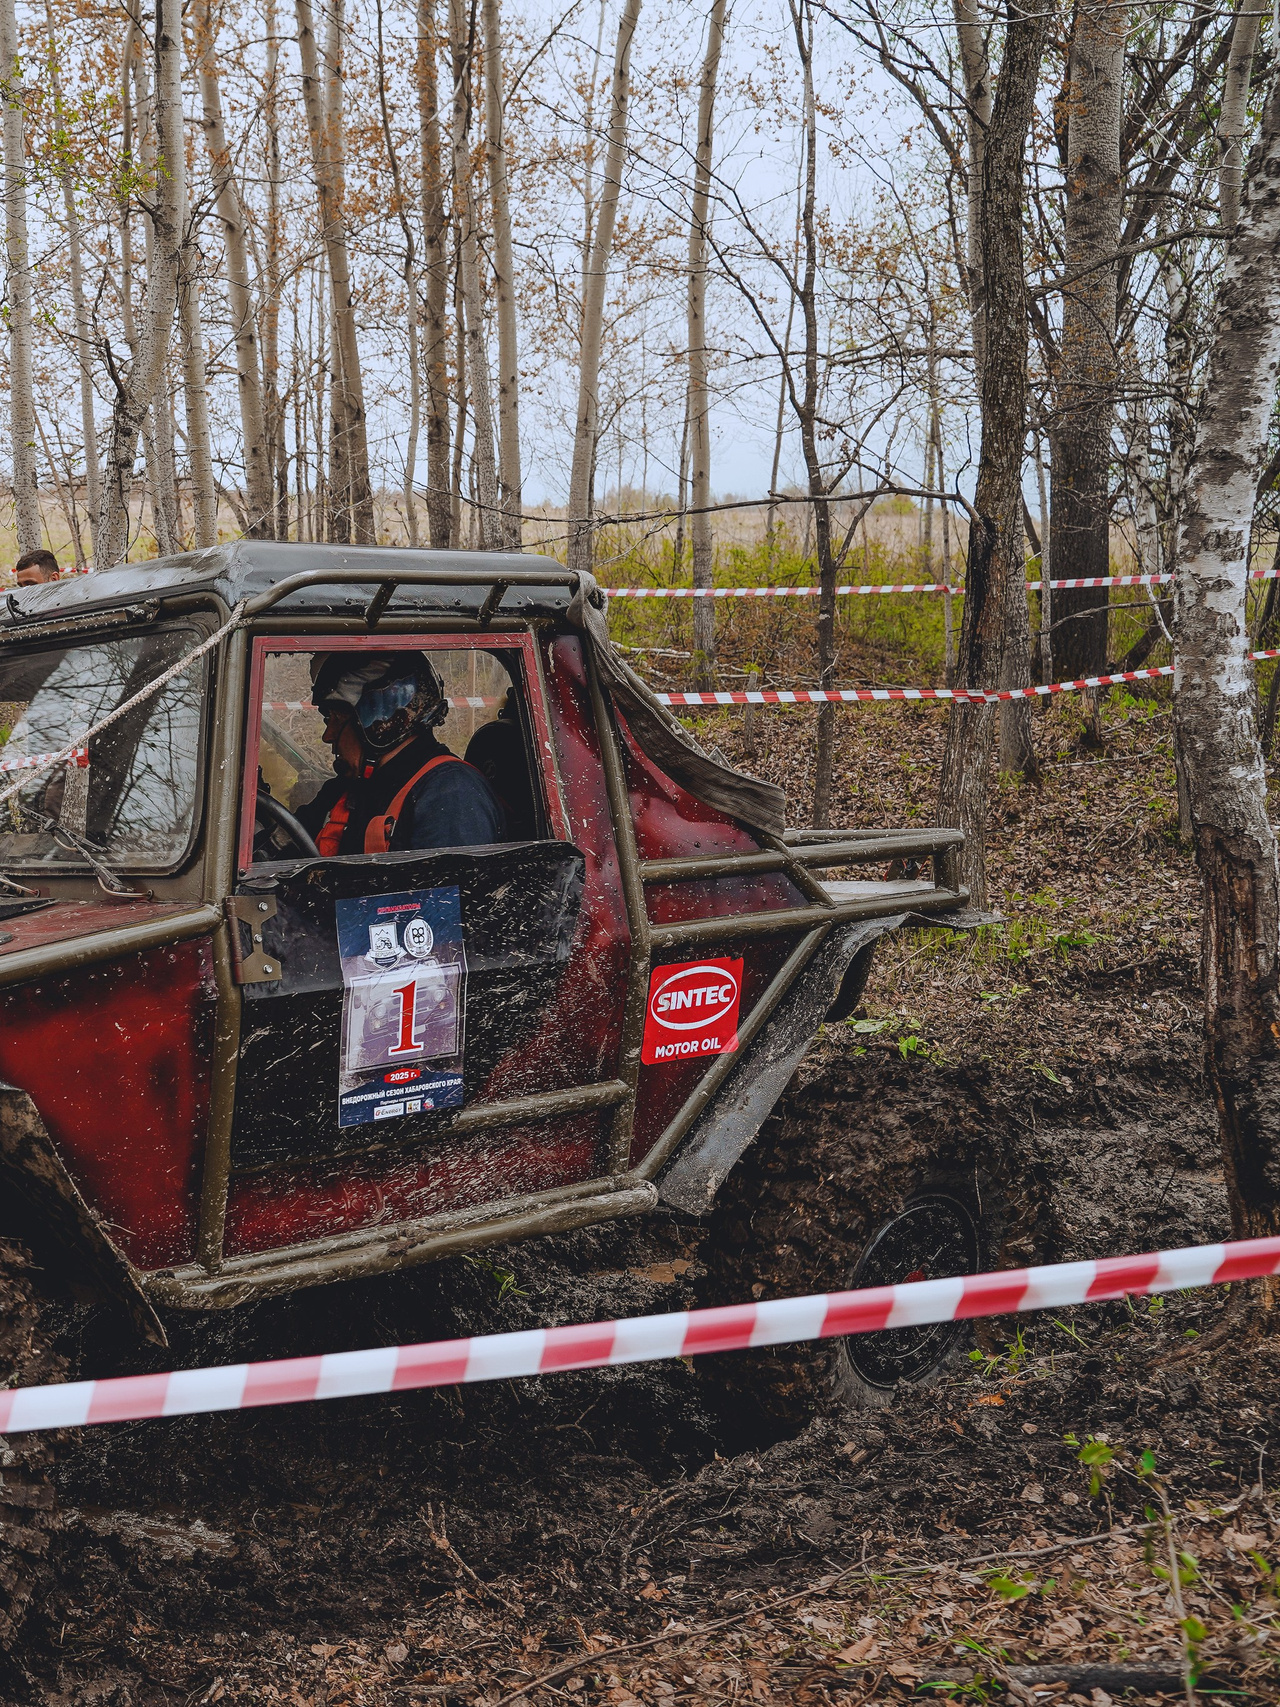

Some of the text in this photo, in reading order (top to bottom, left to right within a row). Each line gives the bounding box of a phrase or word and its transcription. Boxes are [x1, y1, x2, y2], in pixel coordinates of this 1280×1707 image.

[656, 984, 732, 1013] SINTEC
[389, 979, 423, 1056] 1
[655, 1037, 721, 1059] MOTOR OIL
[390, 1071, 409, 1081] 2025
[341, 1090, 386, 1105] ВНЕДОРОЖНЫЙ
[386, 1087, 404, 1098] СЕЗОН
[405, 1080, 446, 1094] ХАБАРОВСКОГО
[446, 1078, 462, 1087] КРАЯ
